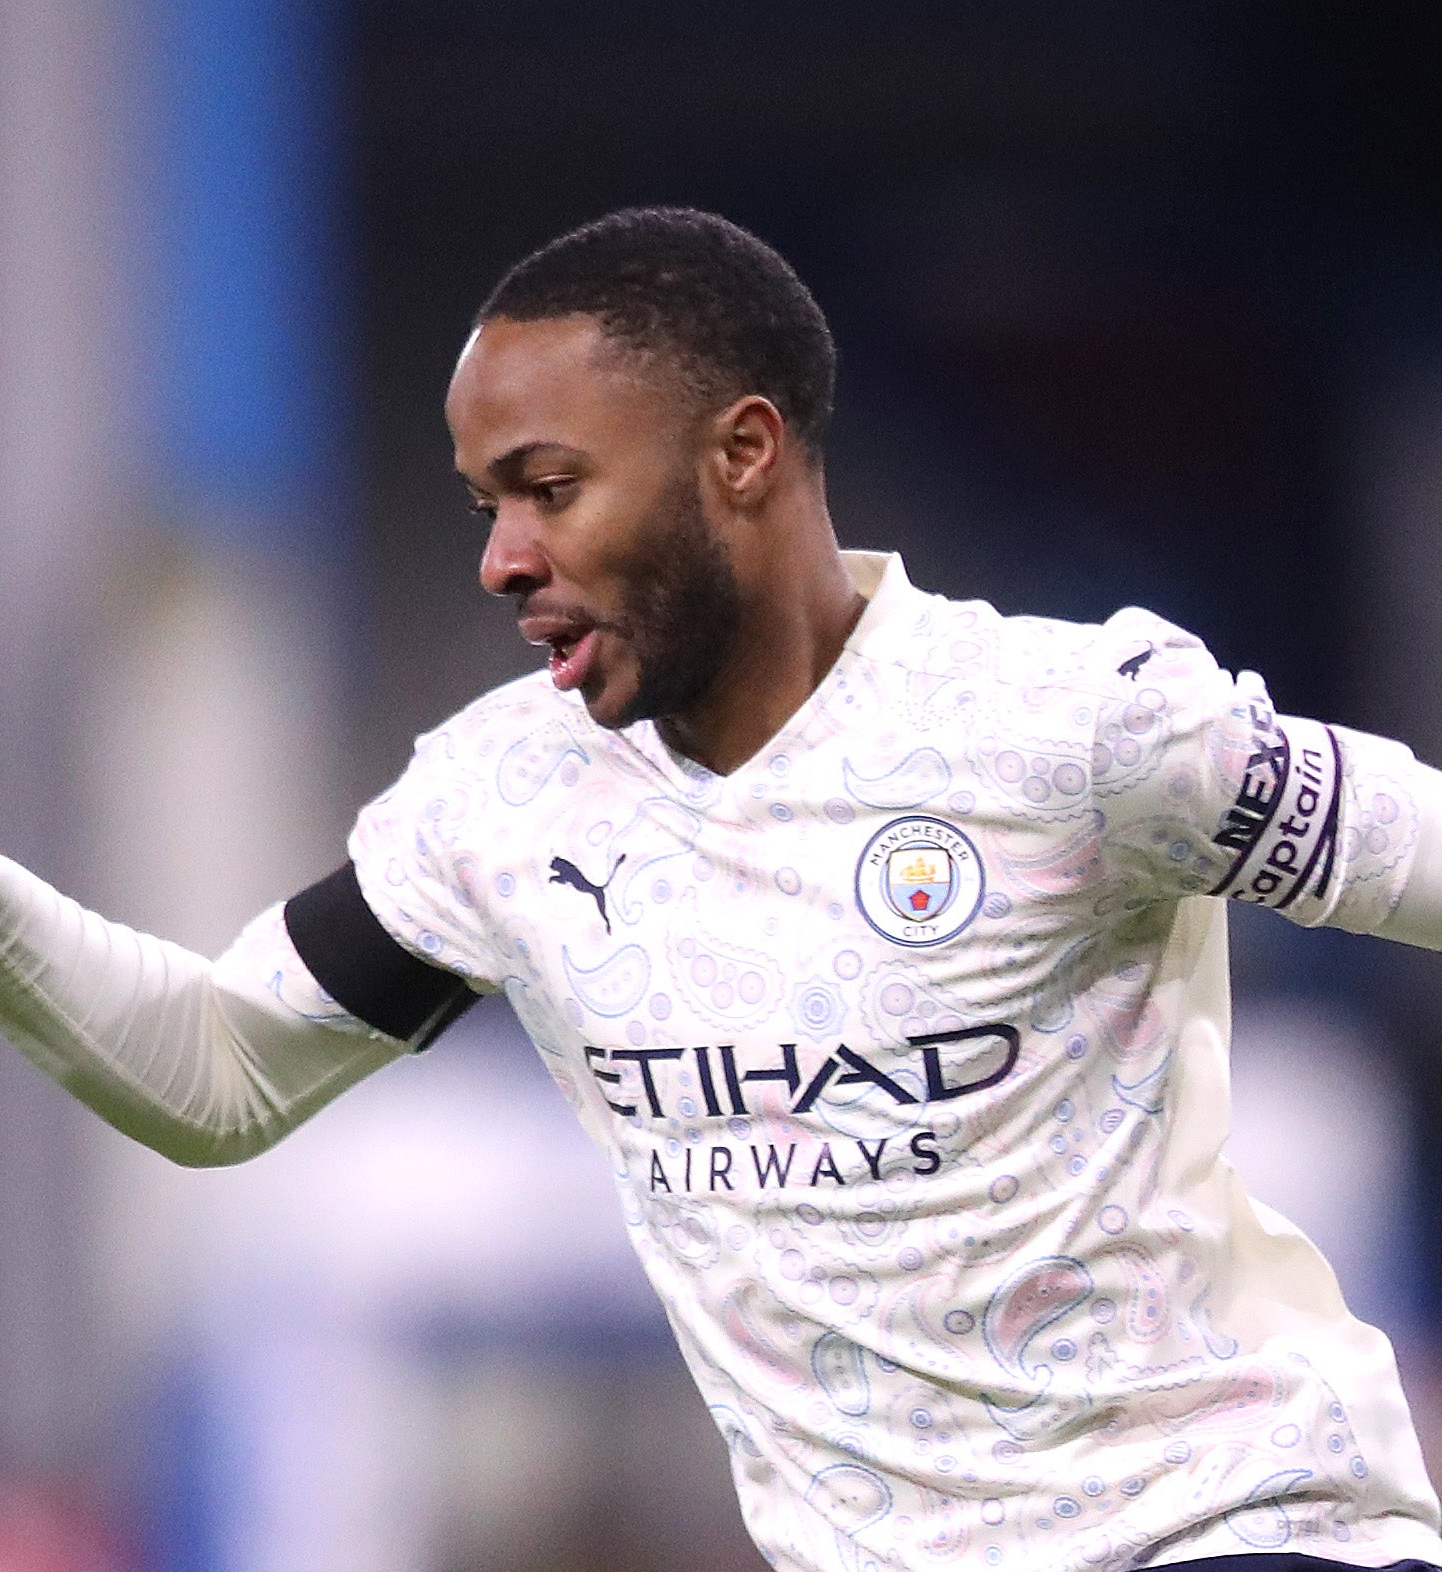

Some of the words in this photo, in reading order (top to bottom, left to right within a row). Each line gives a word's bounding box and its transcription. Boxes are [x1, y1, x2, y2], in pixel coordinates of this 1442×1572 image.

[870, 825, 969, 867] MANCHESTER
[902, 924, 940, 938] CITY
[583, 1022, 1020, 1119] ETIHAD
[650, 1131, 941, 1194] AIRWAYS
